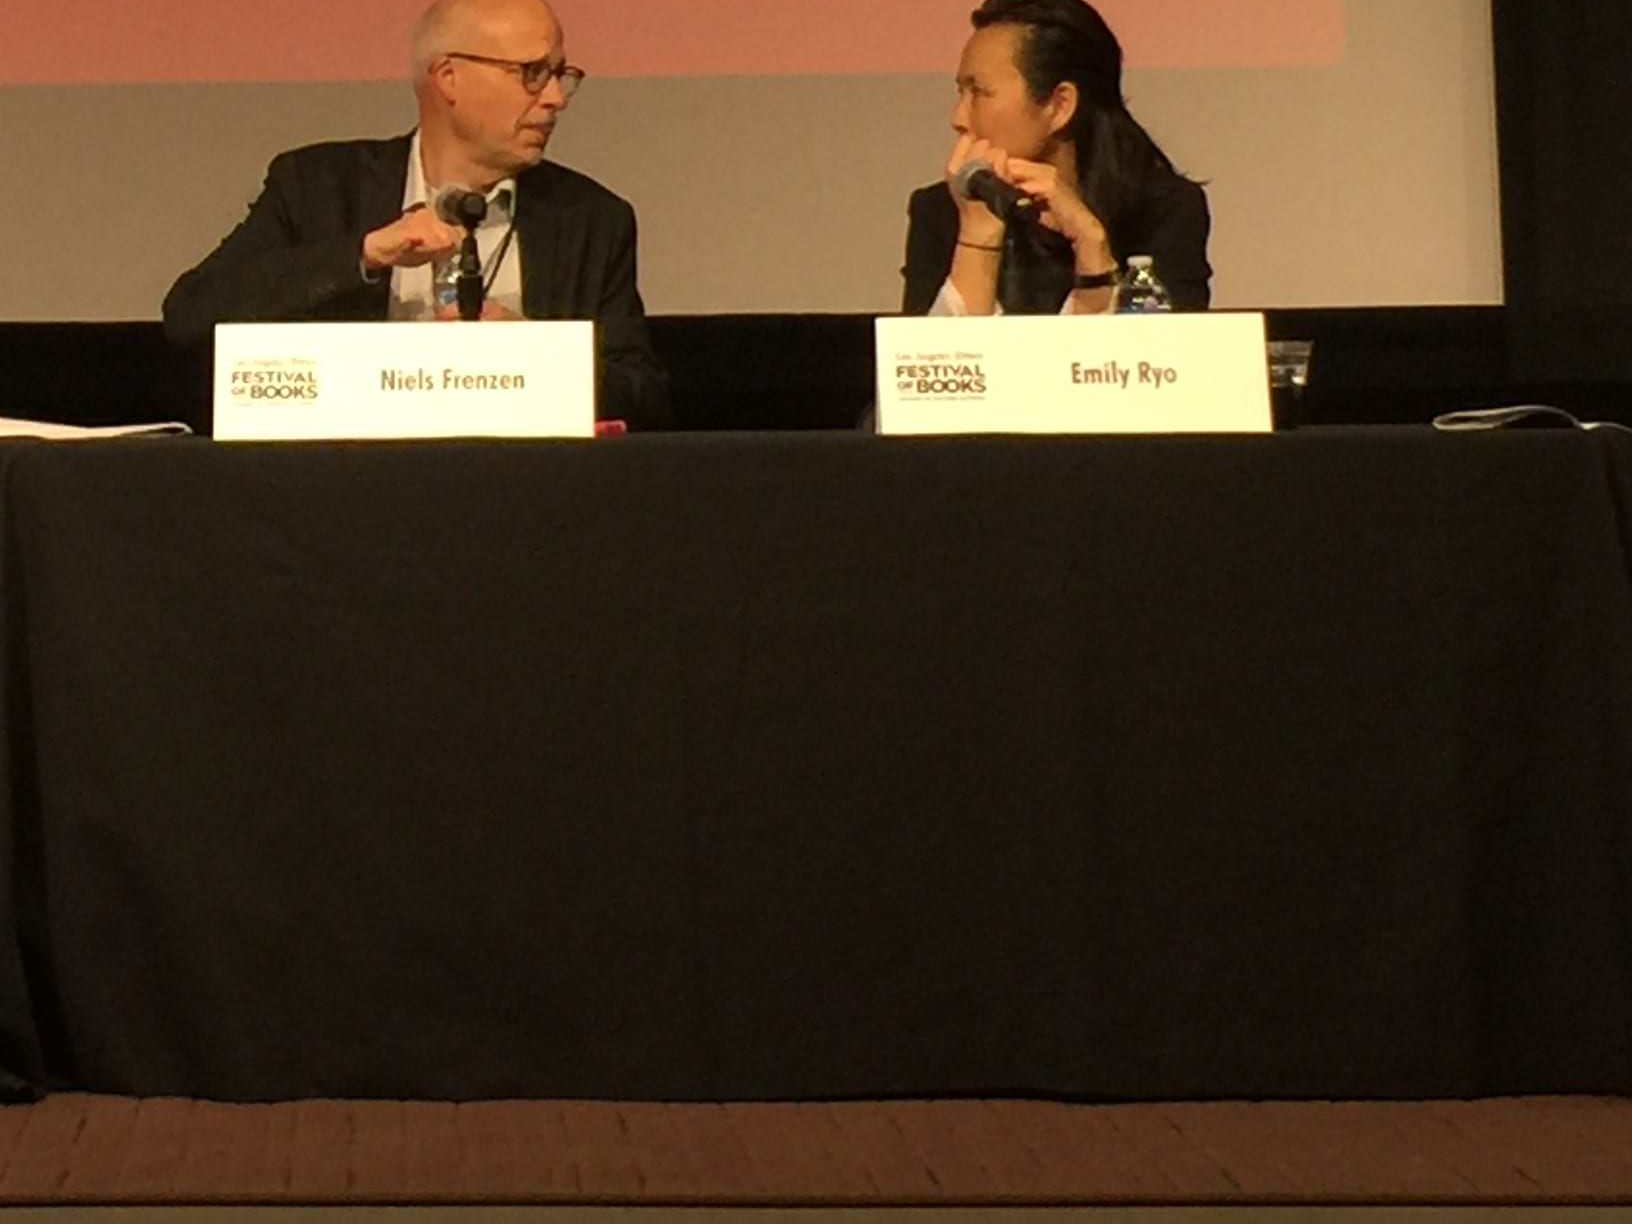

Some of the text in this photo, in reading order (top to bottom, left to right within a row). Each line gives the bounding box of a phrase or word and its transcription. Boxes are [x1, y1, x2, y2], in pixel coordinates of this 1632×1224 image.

[232, 371, 317, 384] FESTIVAL
[896, 365, 985, 378] FESTIVAL
[1071, 360, 1177, 389] Emily Ryo
[380, 368, 525, 391] Niels Frenzen
[916, 379, 986, 394] BOOKS
[250, 385, 318, 400] BOOKS
